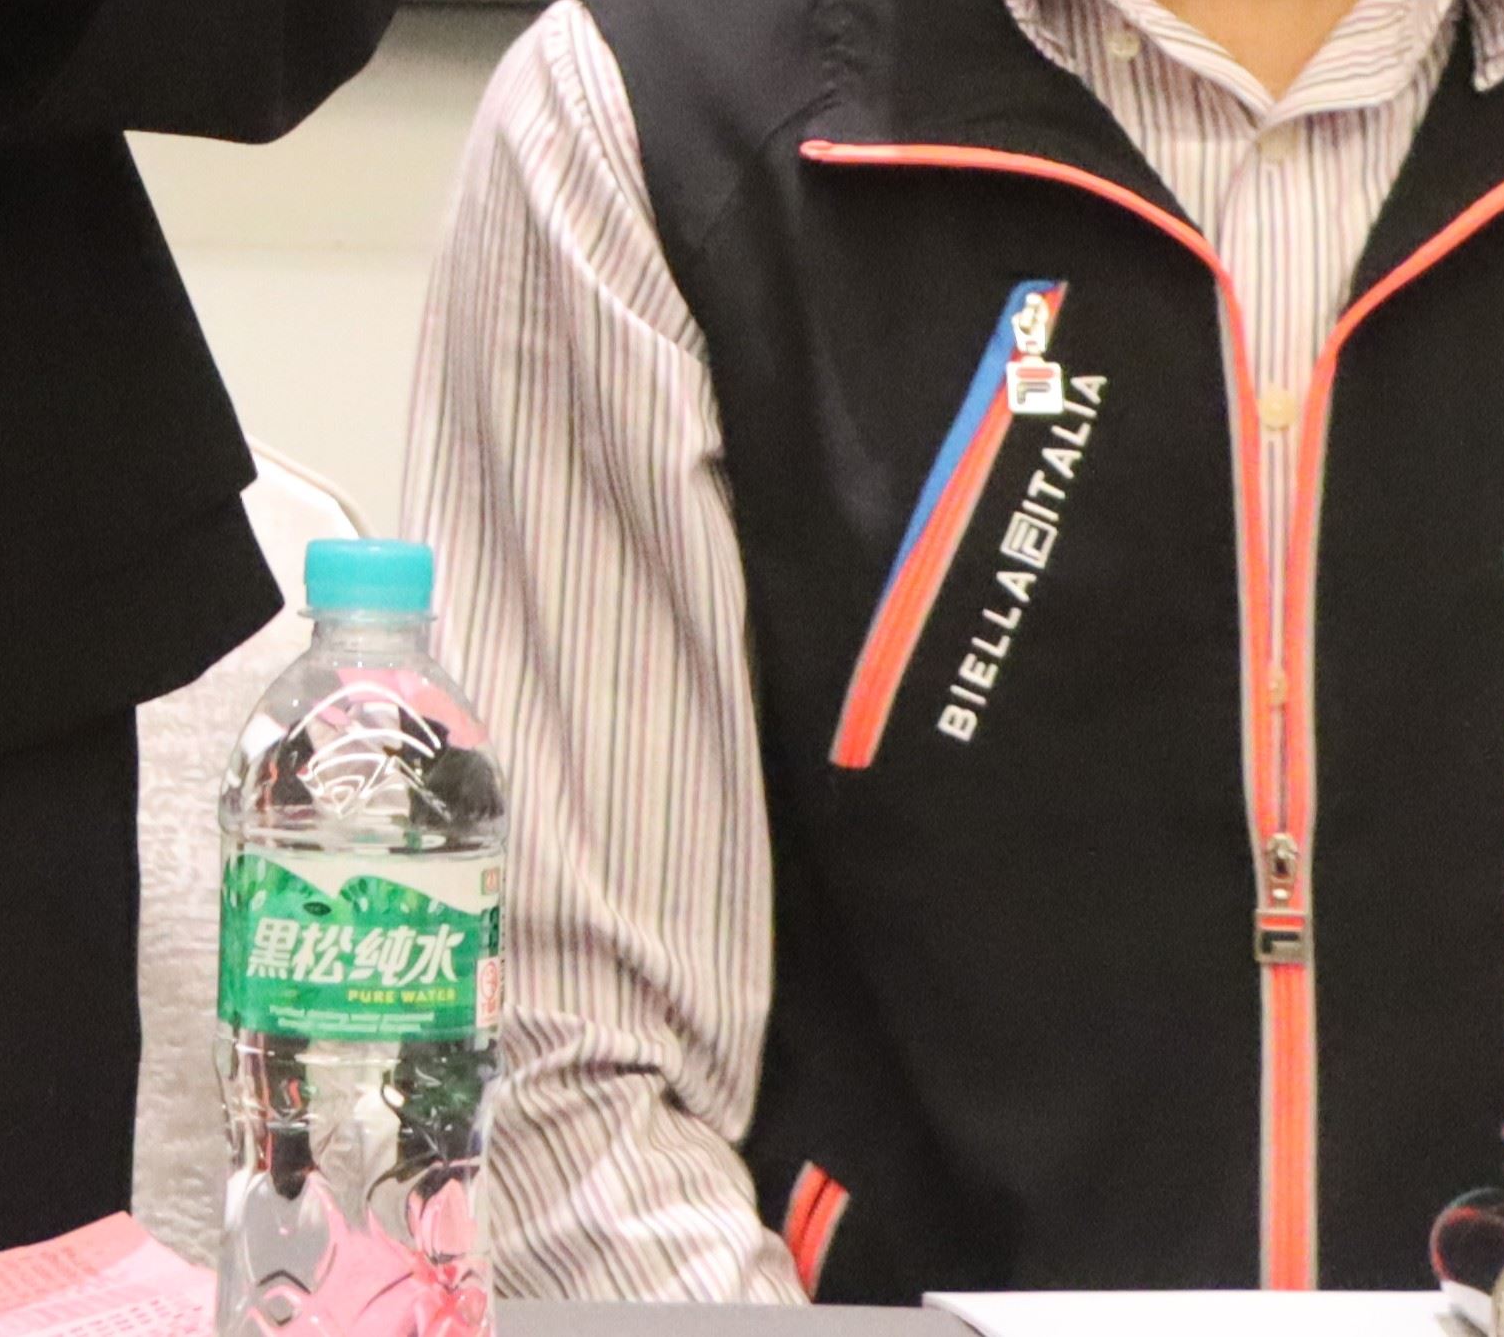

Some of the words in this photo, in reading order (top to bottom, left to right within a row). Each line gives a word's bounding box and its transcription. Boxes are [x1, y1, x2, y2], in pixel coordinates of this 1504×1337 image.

[937, 570, 1037, 742] BIELLA
[1023, 375, 1107, 521] ITALIA
[348, 989, 396, 1004] PURE
